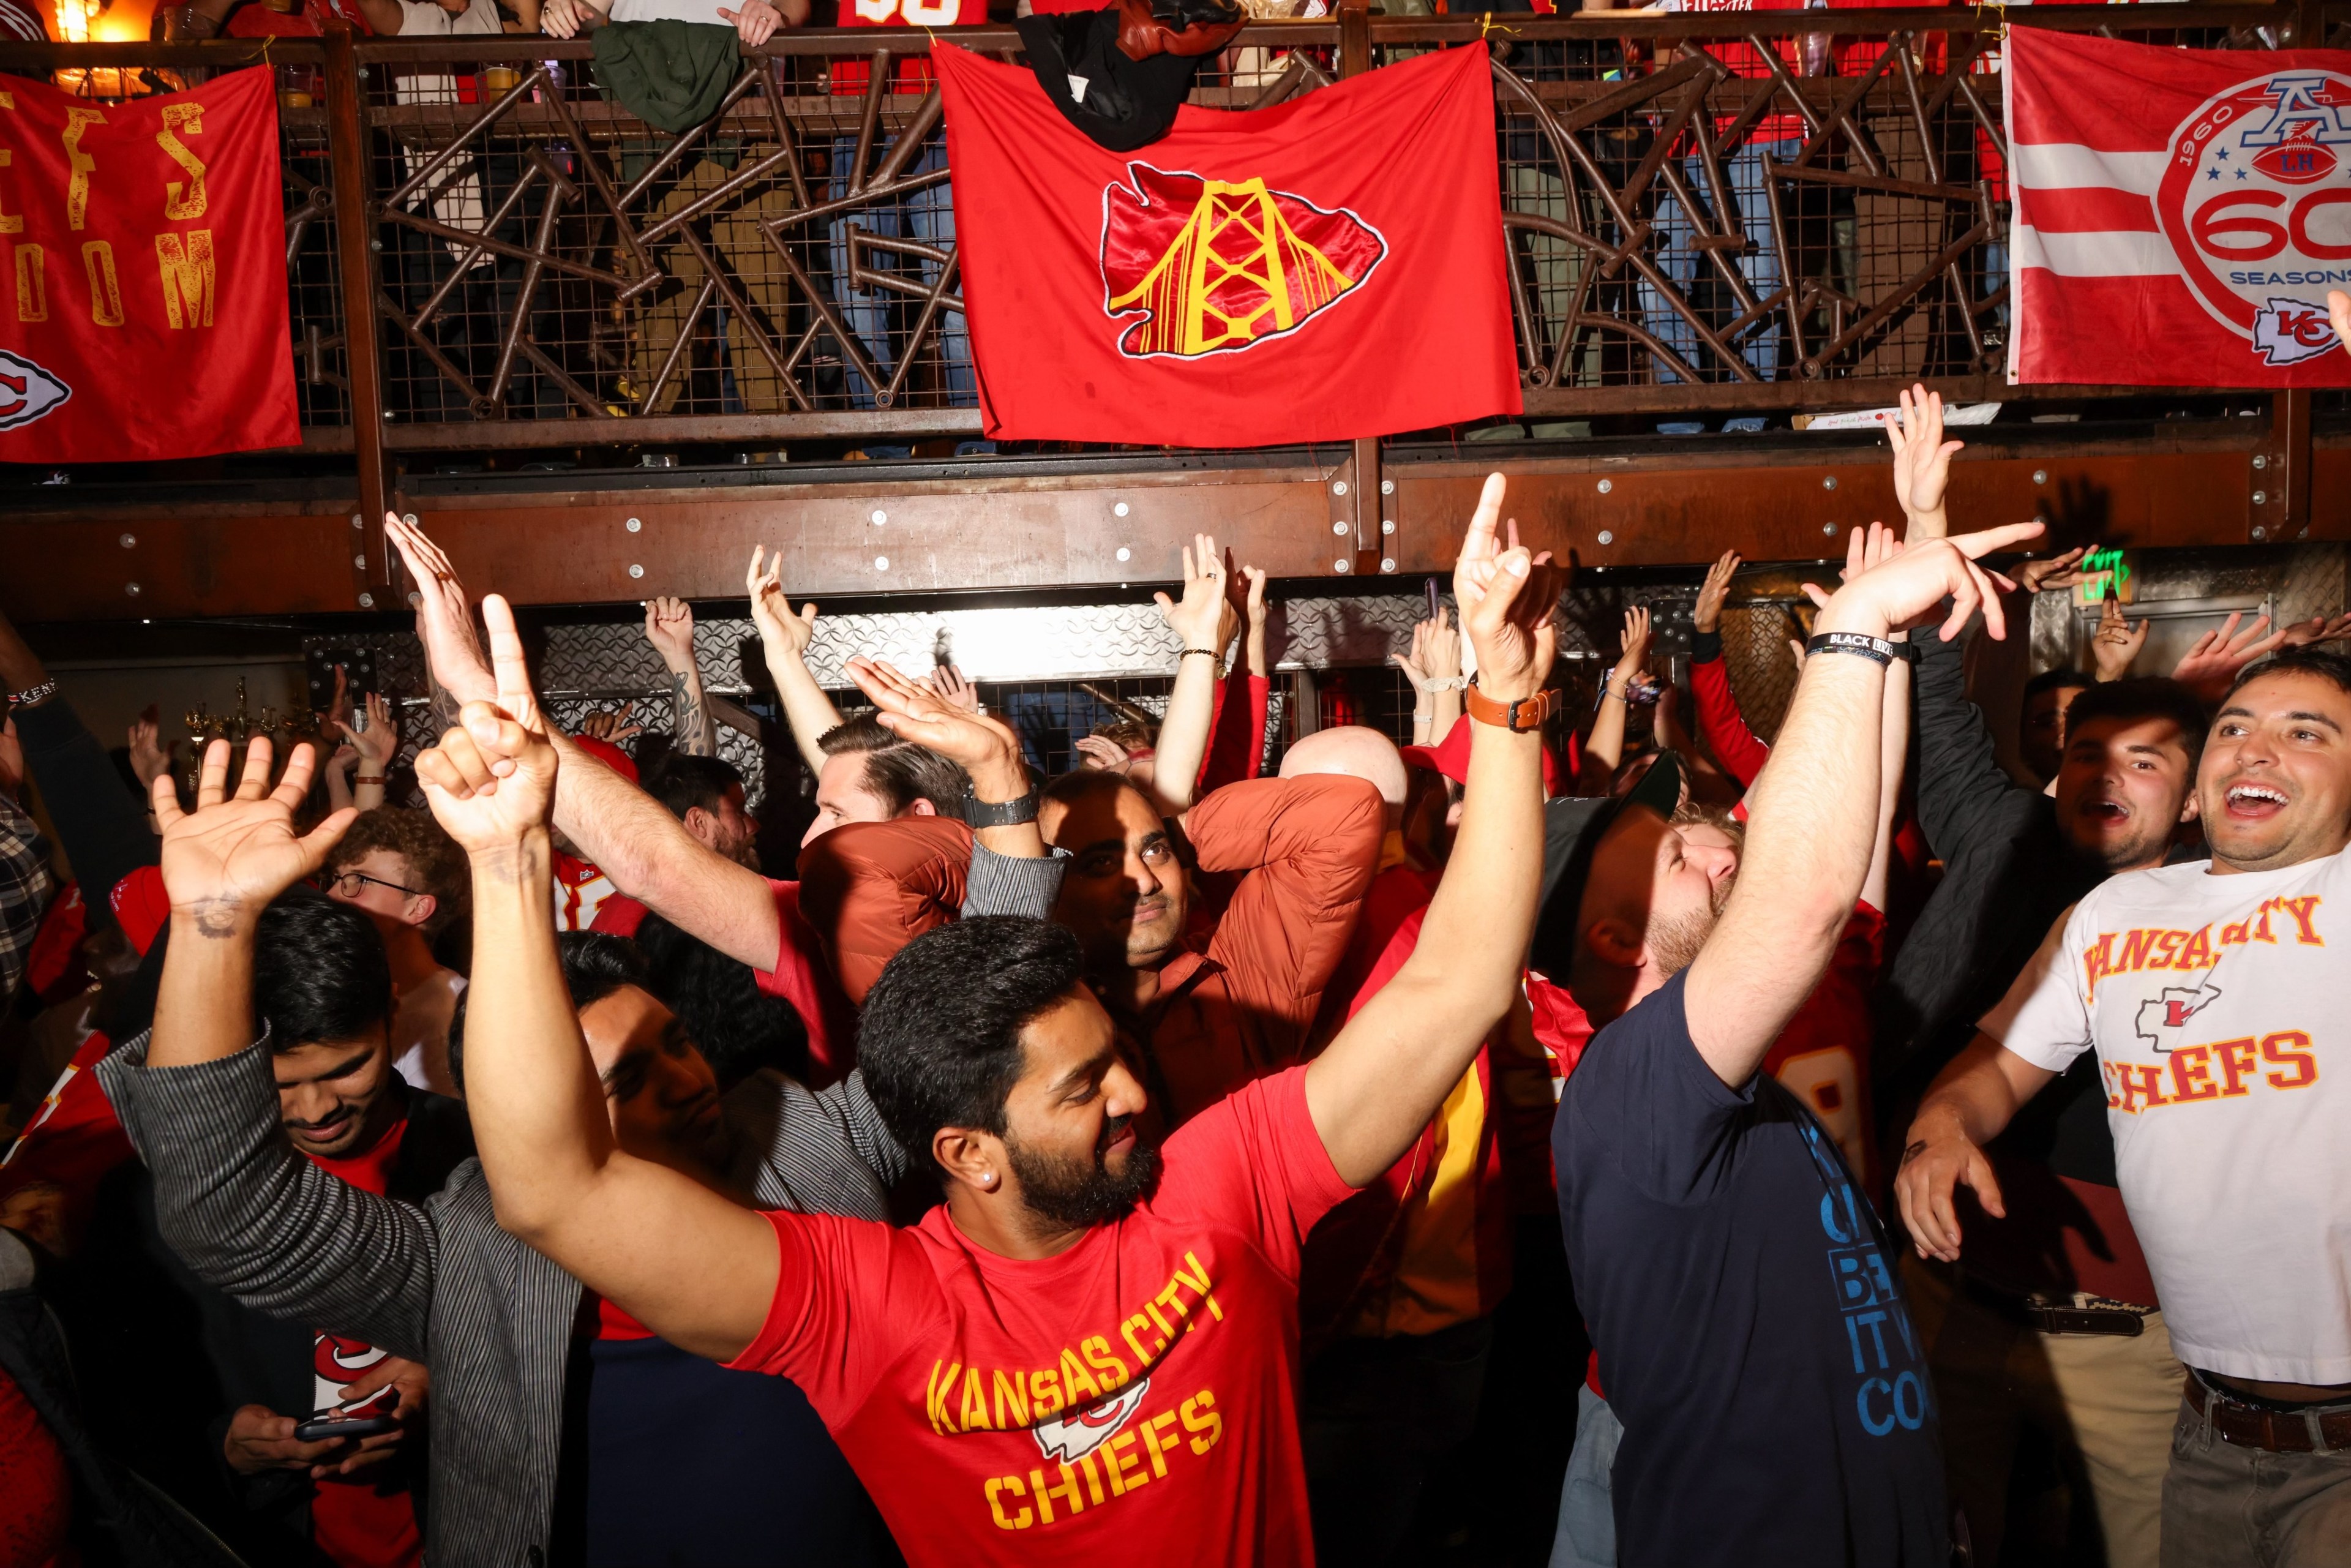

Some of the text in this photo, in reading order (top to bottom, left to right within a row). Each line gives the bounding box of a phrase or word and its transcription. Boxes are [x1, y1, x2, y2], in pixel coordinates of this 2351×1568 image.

[2180, 106, 2232, 167] 1960
[2230, 269, 2351, 285] SEASON
[2277, 311, 2334, 347] KC
[1830, 634, 1870, 647] BLACK
[2083, 921, 2222, 1005] KANSA
[2103, 1029, 2319, 1114] CHEFS
[927, 1251, 1223, 1436] KANSAS CITY
[984, 1390, 1222, 1530] CHIEFS
